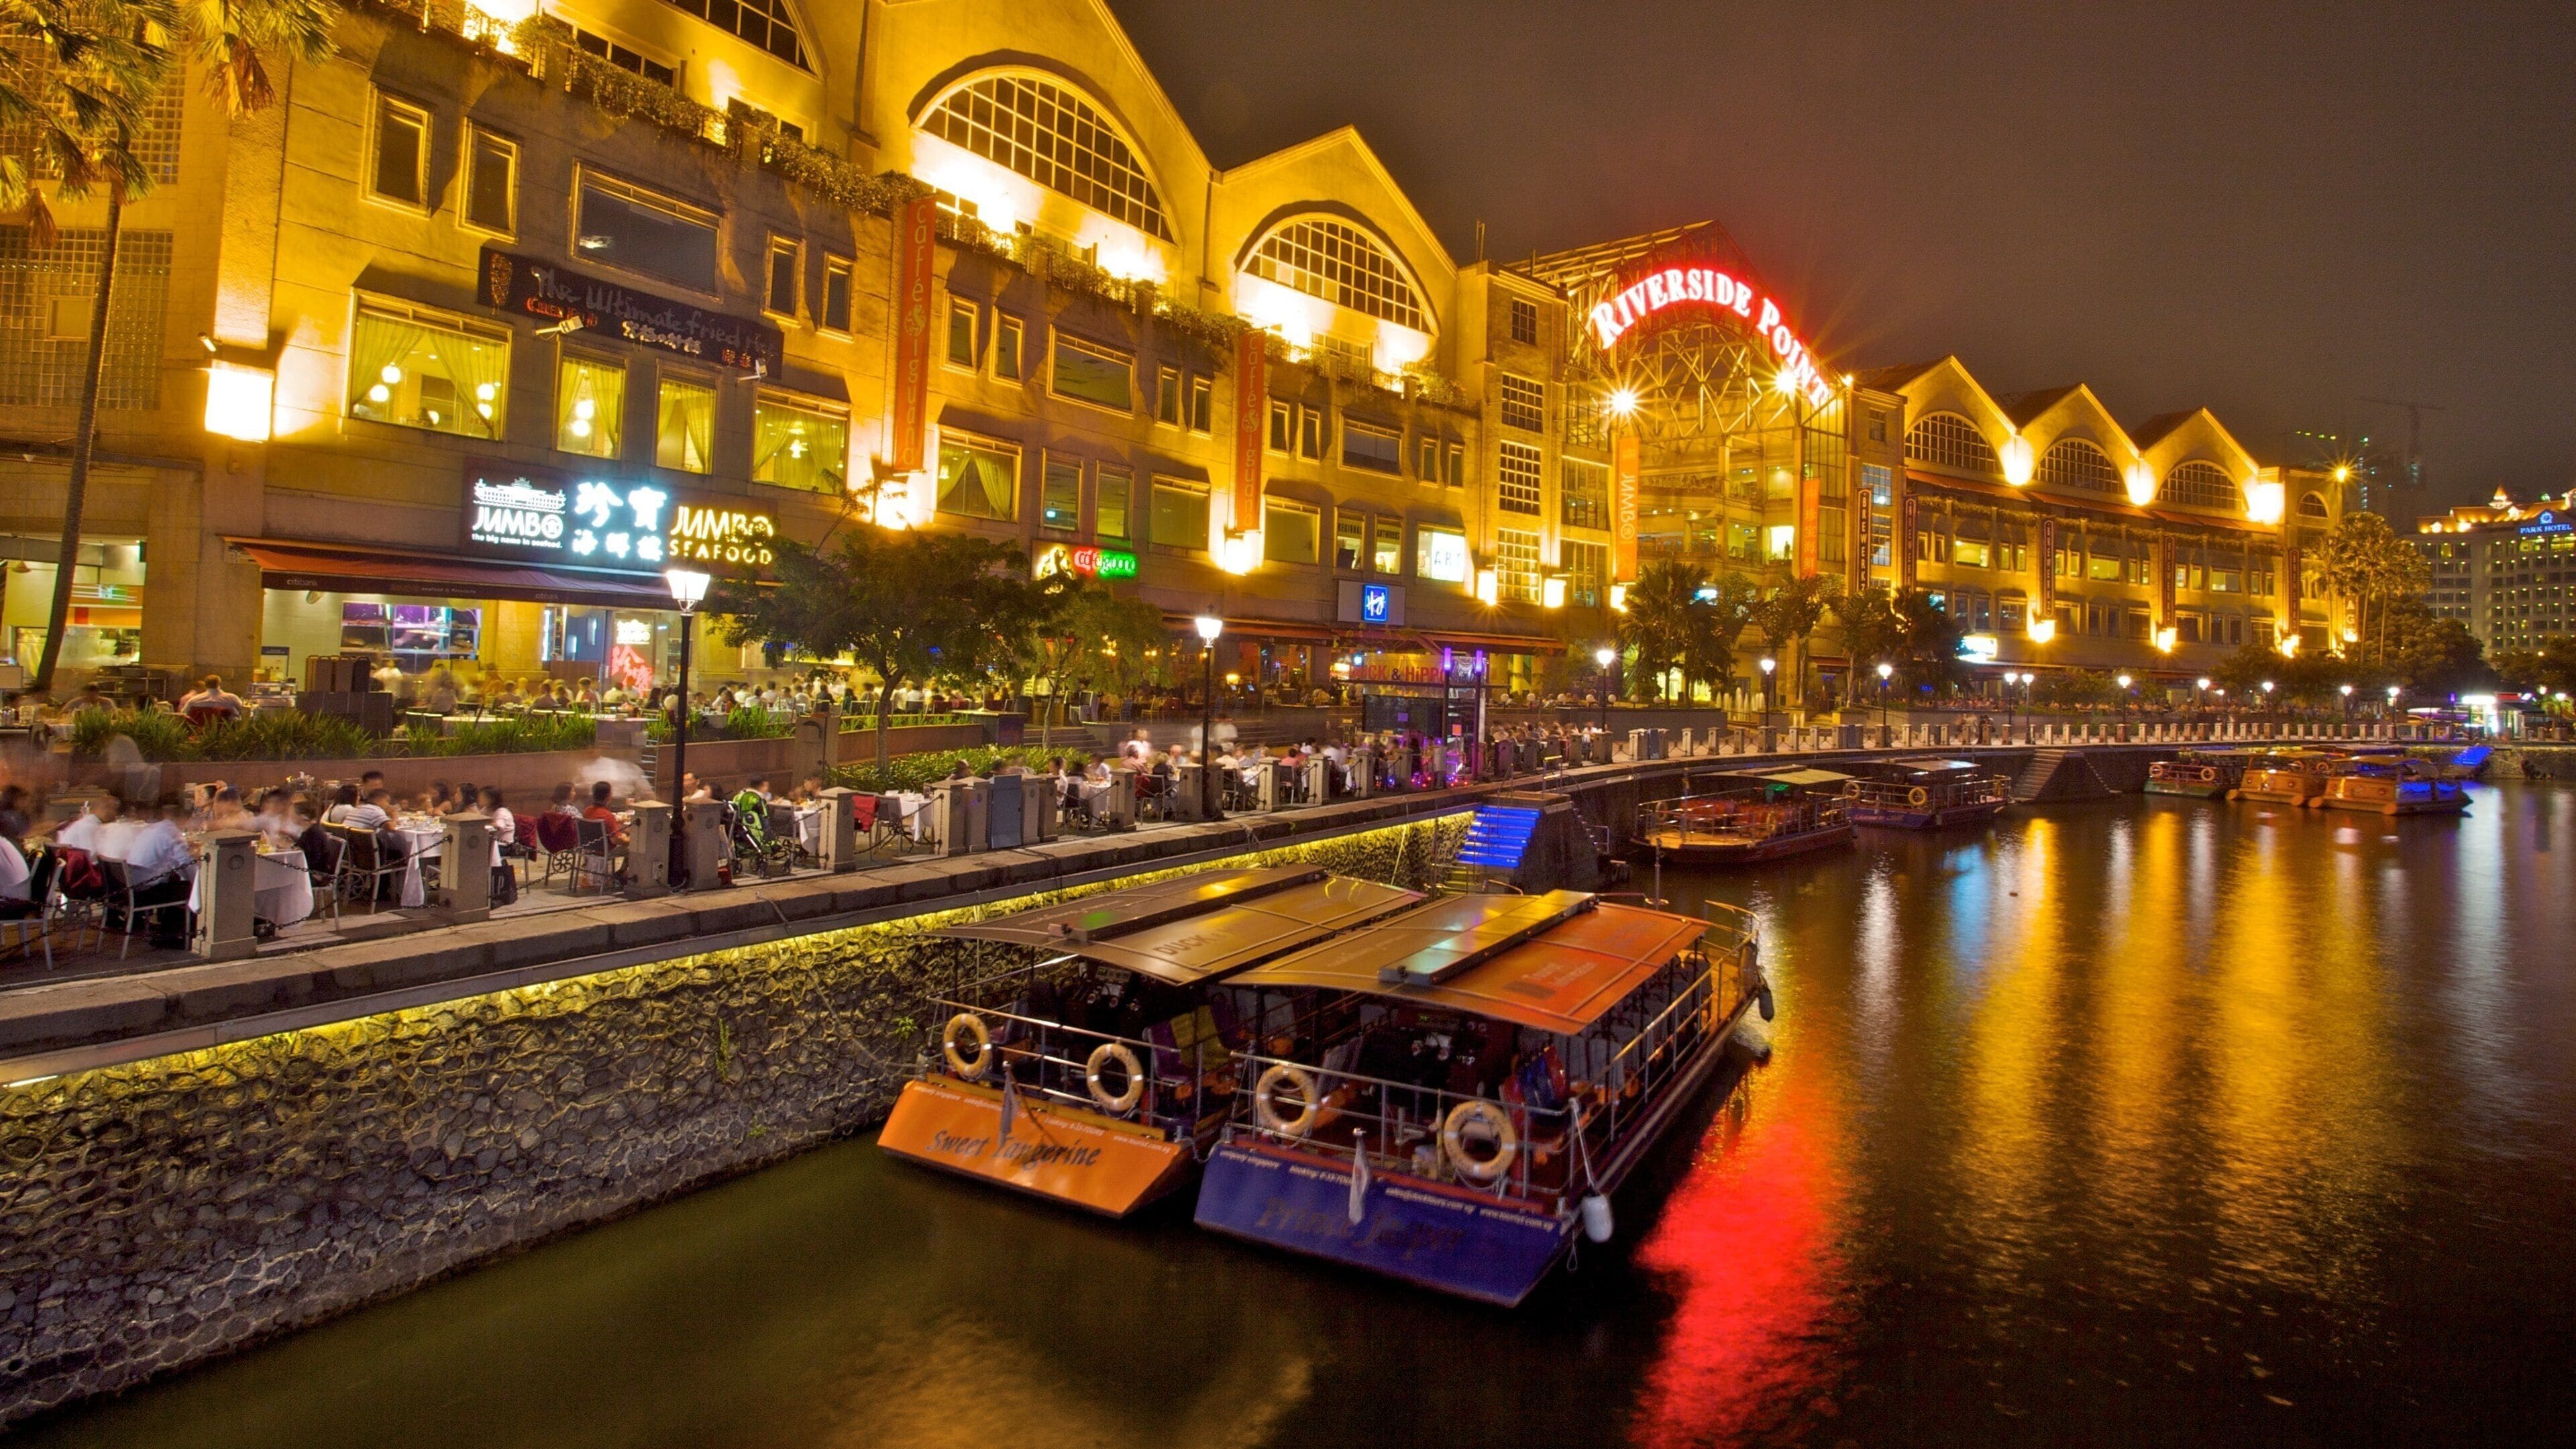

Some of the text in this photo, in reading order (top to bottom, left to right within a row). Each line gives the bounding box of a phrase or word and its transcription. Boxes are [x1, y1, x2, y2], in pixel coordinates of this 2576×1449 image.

[531, 267, 581, 302] The
[902, 337, 920, 466] iguana
[1621, 471, 1635, 539] JUMBO
[472, 506, 564, 539] JUMBO
[670, 505, 774, 546] JUMBO
[2520, 523, 2573, 534] PARK HOTEL
[472, 533, 485, 541] the
[486, 534, 500, 544] big
[500, 536, 521, 545] name
[523, 537, 531, 547] in
[669, 539, 772, 565] SEAFOOD
[1391, 667, 1401, 681] &
[925, 1130, 1101, 1171] Sweet Tangerine
